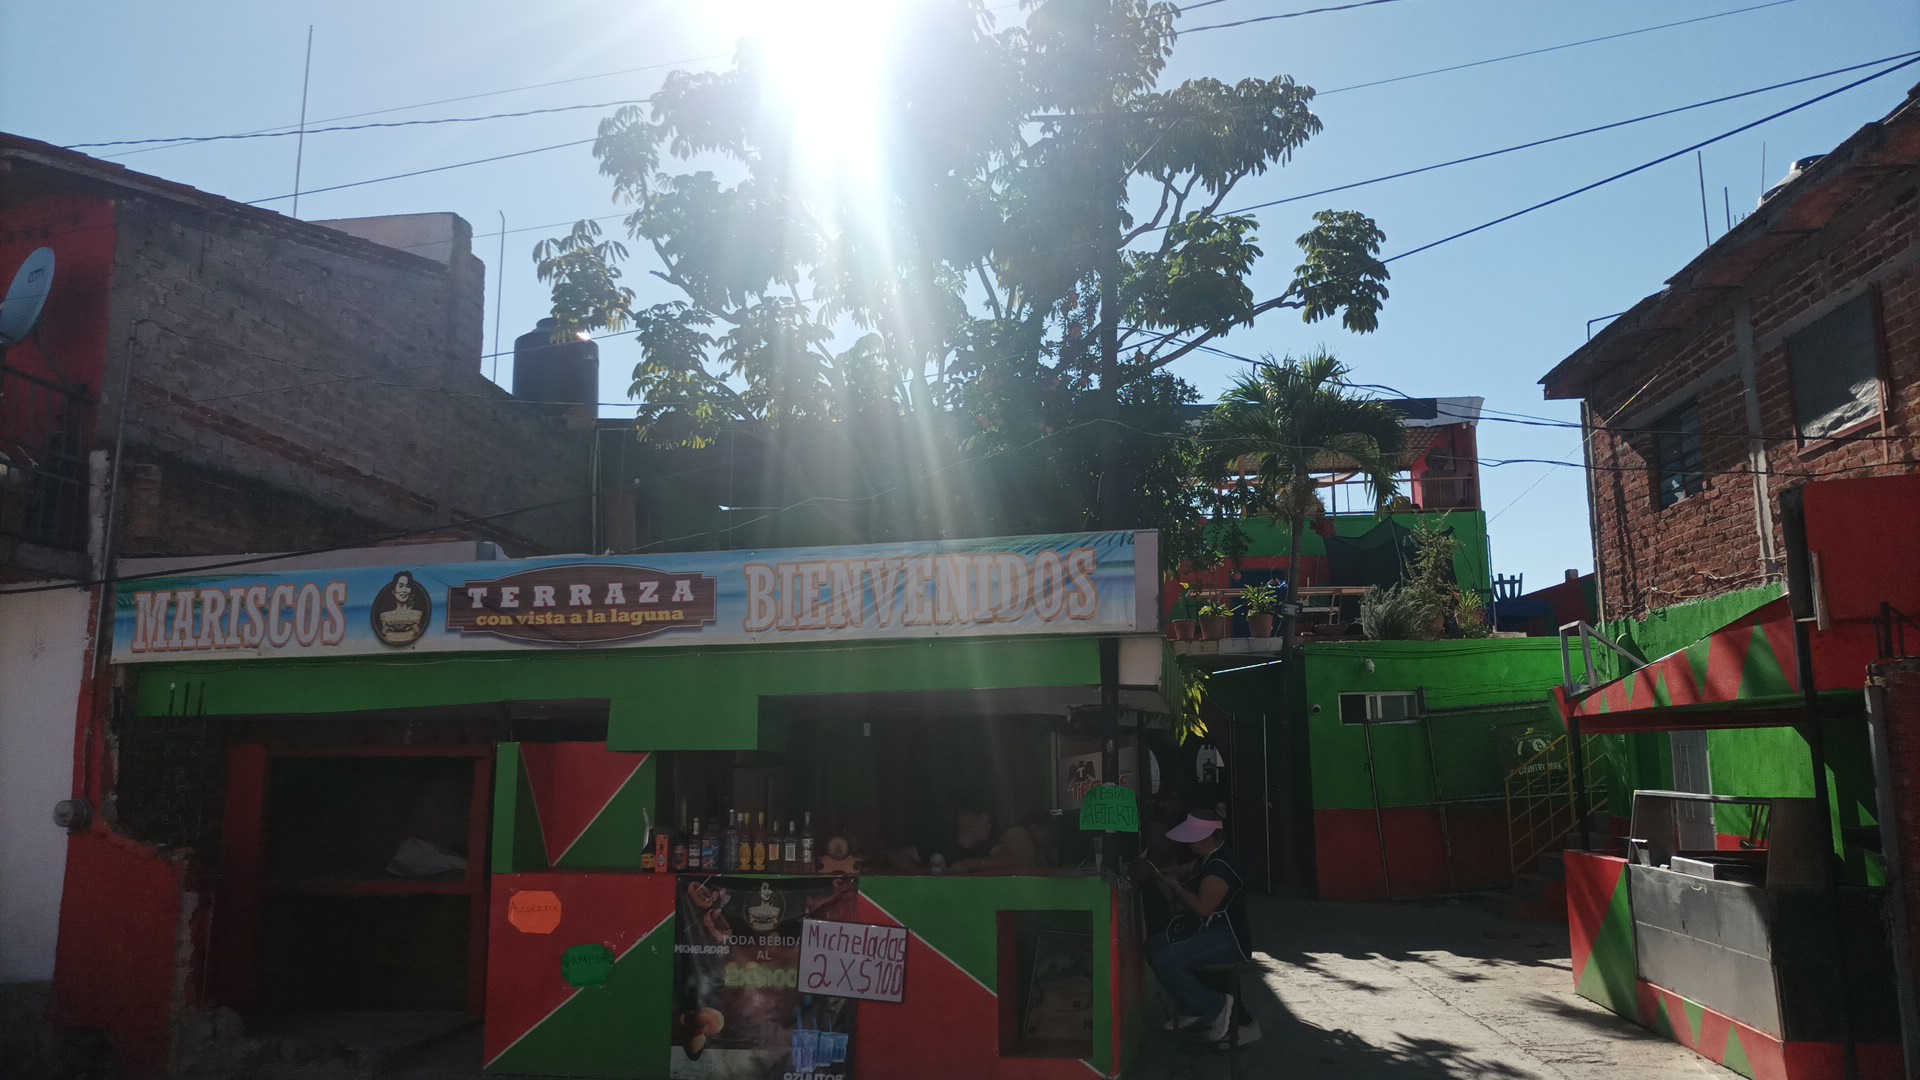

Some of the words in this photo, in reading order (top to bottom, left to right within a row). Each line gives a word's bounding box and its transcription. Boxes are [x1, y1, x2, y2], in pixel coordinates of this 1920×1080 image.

[468, 580, 694, 608] TERRAZA
[744, 548, 1099, 632] BIENVENIDOS
[131, 580, 347, 652] MARISCOS
[476, 613, 513, 626] con
[516, 611, 565, 625] vista
[571, 612, 583, 624] a
[587, 610, 605, 624] la
[611, 608, 684, 626] laguna
[1082, 802, 1138, 826] ABIERTO
[674, 944, 730, 955] MICHELADAS
[722, 935, 756, 946] TODA
[808, 924, 906, 963] Micheladas
[756, 950, 771, 960] AL
[808, 954, 831, 989] 2
[857, 958, 903, 995] $100
